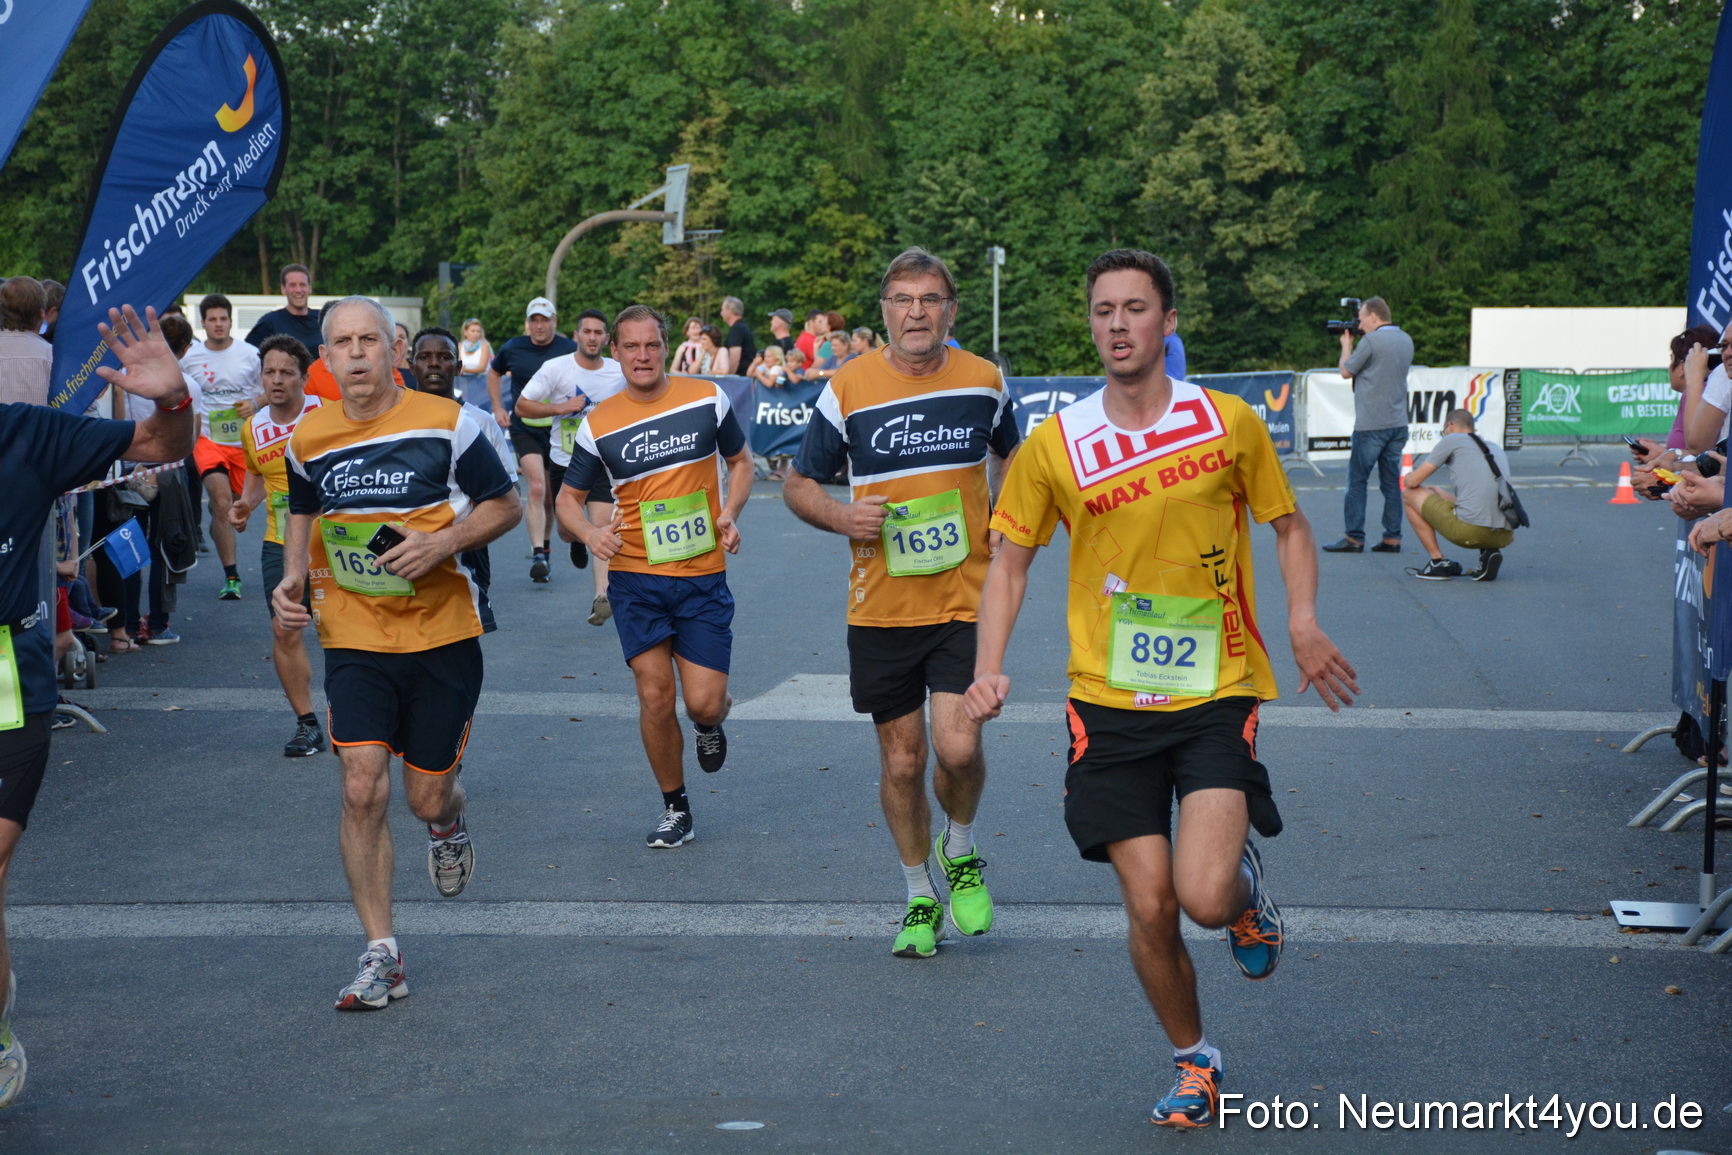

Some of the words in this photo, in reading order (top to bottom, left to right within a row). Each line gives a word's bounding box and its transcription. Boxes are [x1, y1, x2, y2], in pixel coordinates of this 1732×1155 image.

[175, 194, 211, 239] Druck
[233, 122, 277, 181] Medien
[81, 140, 227, 306] Frischmann
[1529, 383, 1582, 413] AOK
[1621, 406, 1634, 418] IN
[1637, 404, 1678, 418] BESTEN
[221, 421, 238, 433] 96
[889, 424, 974, 448] Fischer
[636, 431, 699, 458] Fischer
[643, 443, 696, 463] AUTOMOBILE
[899, 441, 970, 457] AUTOMOBILE
[333, 469, 415, 491] Fischer
[339, 486, 408, 498] AUTOMOBILE
[1084, 476, 1152, 517] MAX
[1158, 449, 1233, 489] BÖGL
[651, 516, 707, 546] 1618
[892, 522, 960, 555] 1633
[0, 537, 13, 554] s!
[1131, 632, 1197, 668] 892
[1136, 670, 1158, 681] Tobias
[1158, 673, 1188, 682] Eckstein
